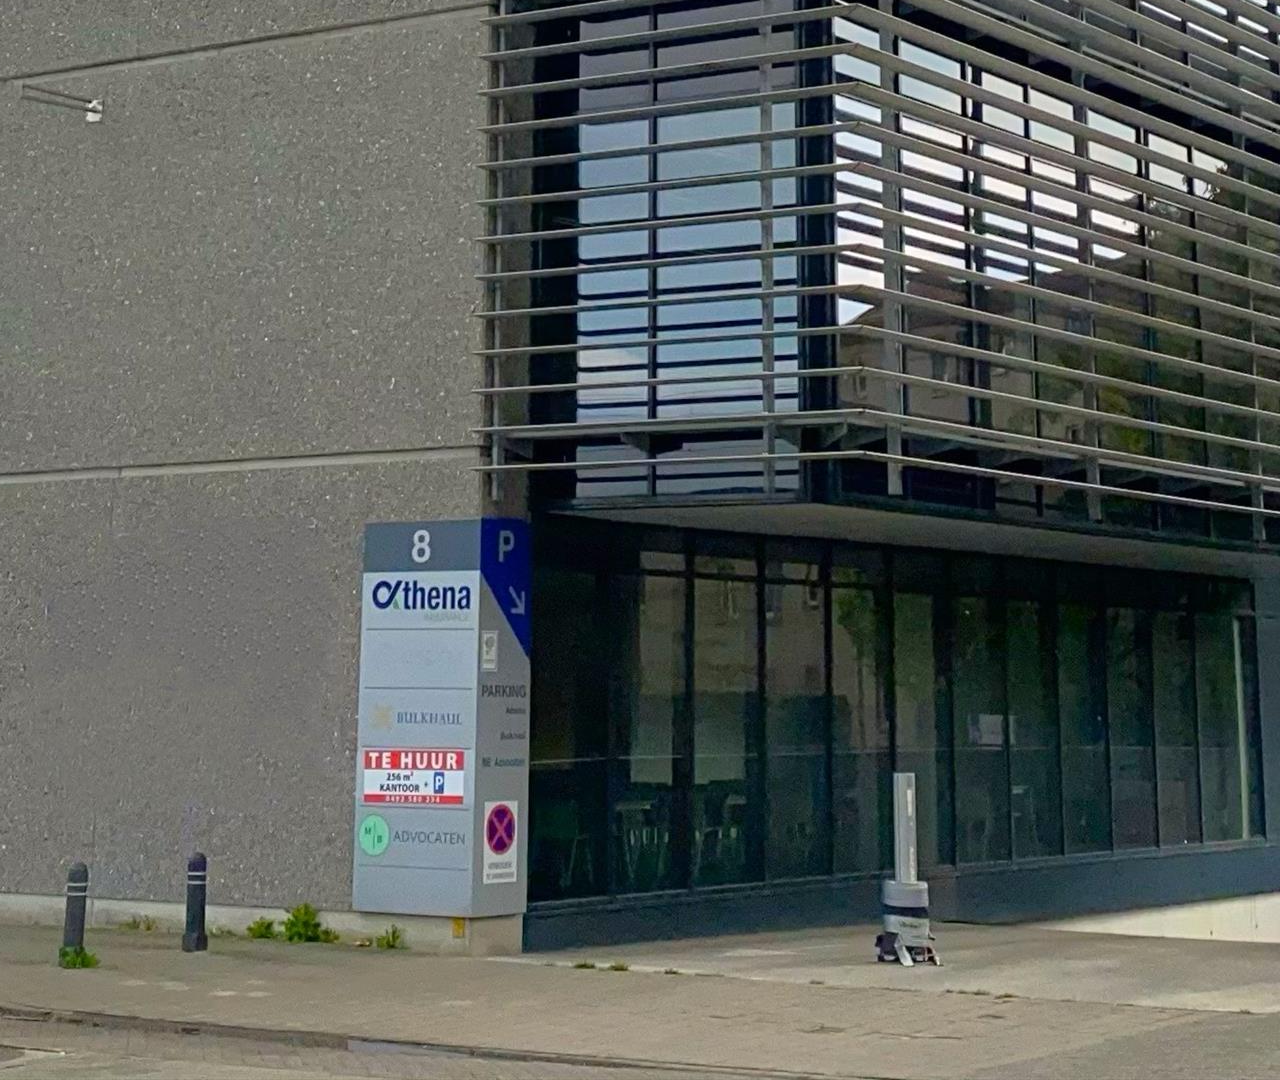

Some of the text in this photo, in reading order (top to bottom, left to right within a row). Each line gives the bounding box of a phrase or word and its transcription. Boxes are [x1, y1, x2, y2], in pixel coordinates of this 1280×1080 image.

[412, 529, 431, 563] 8
[498, 530, 515, 562] P
[481, 685, 527, 698] PARKING
[396, 711, 463, 725] BULKHAUL
[368, 751, 458, 770] TE HUUR
[379, 783, 420, 793] KANTOOR
[393, 830, 466, 845] ADVOCATEN
